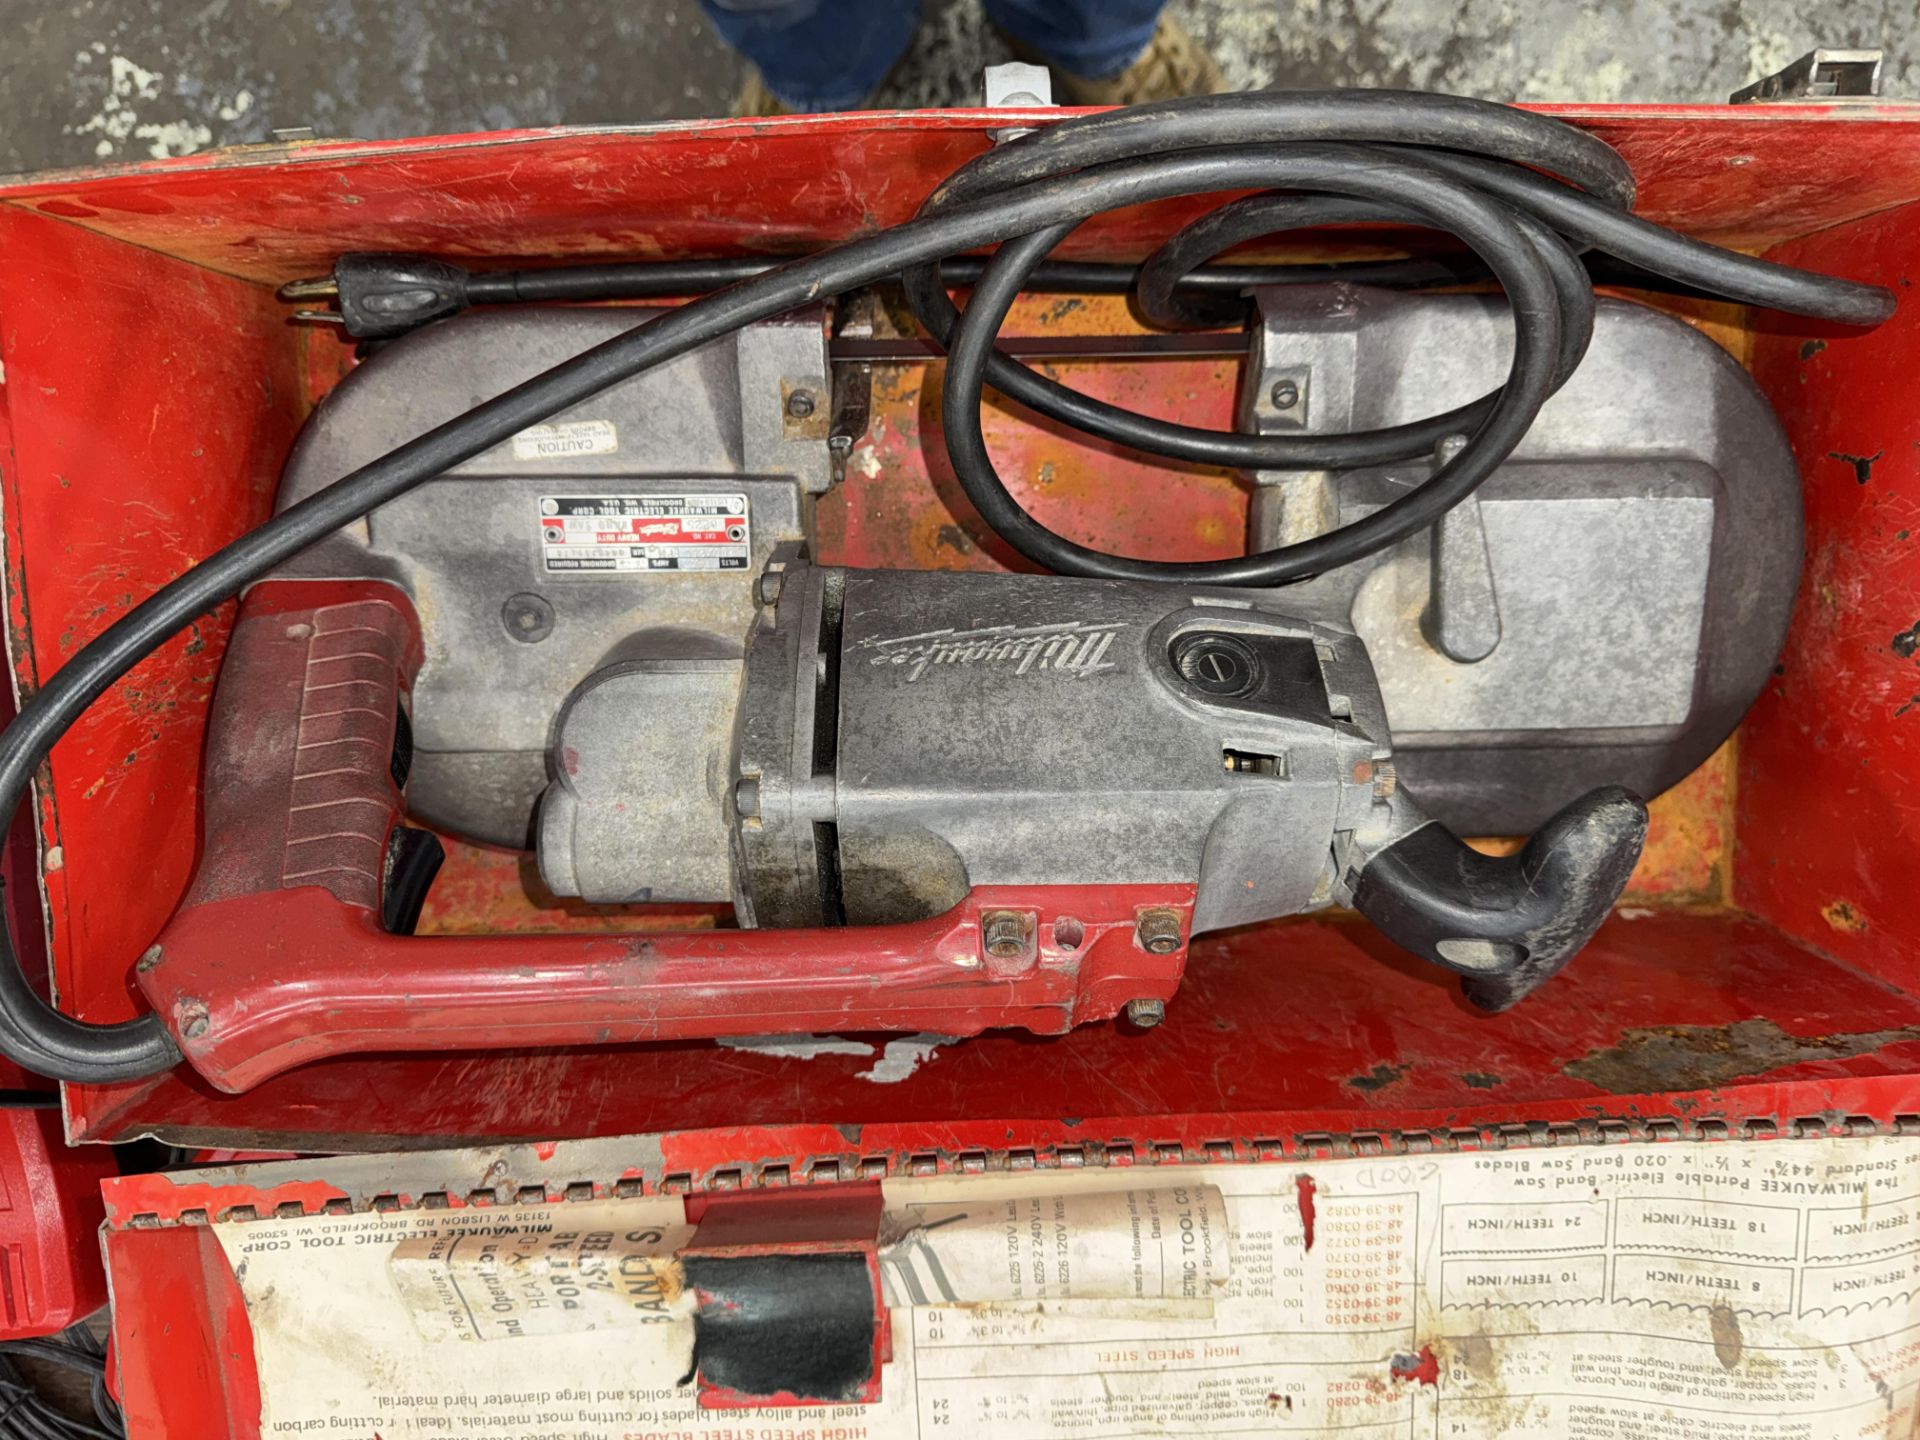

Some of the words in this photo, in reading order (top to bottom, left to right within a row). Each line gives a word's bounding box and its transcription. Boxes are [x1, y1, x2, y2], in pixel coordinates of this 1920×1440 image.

[537, 440, 592, 454] CAUTION
[569, 507, 595, 515] CORP.
[599, 507, 619, 515] TOOL
[624, 507, 664, 515] ELECTRIC
[668, 507, 717, 515] MILWAUKEE
[869, 634, 1118, 681] Milwaukee
[1473, 1160, 1530, 1174] Blades
[1540, 1159, 1574, 1173] Saw
[1582, 1156, 1624, 1170] Band
[1633, 1154, 1672, 1167] .020
[1682, 1155, 1692, 1166] x
[1825, 1159, 1898, 1177] Standard
[1513, 1177, 1545, 1189] Saw
[1555, 1175, 1596, 1188] Band
[1606, 1172, 1664, 1187] Electric
[1675, 1172, 1750, 1189] Portable
[1874, 1175, 1898, 1188] The
[1760, 1179, 1866, 1195] MILWAUKEE
[1325, 1203, 1403, 1216] 48-39-0382
[413, 1218, 434, 1227] RD.
[442, 1214, 490, 1225] LISBON
[495, 1214, 510, 1222] W.
[515, 1212, 551, 1221] 13135
[1564, 1216, 1581, 1227] 24
[1642, 1212, 1736, 1231] TEETH/INCH
[318, 1220, 407, 1234] BROOKFIELD,
[1151, 1217, 1162, 1239] Date
[1325, 1218, 1403, 1232] 48-39-0380
[1467, 1218, 1554, 1229] TEETH/INCH
[1747, 1221, 1767, 1234] 18
[1832, 1213, 1909, 1236] TEETH/INCH
[248, 1230, 288, 1240] 53005
[292, 1227, 312, 1236] WI.
[355, 1229, 438, 1245] ELECTRIC
[447, 1224, 553, 1238] MILWAUKEE
[1178, 1208, 1195, 1256] TOOL
[1247, 1231, 1273, 1239] slow
[299, 1236, 345, 1248] TOOL
[1006, 1224, 1019, 1258] 120V
[1055, 1222, 1068, 1257] 120V
[1325, 1233, 1402, 1247] 48-39-0372
[238, 1241, 291, 1253] CORP.
[1238, 1242, 1273, 1251] steels
[1325, 1249, 1402, 1262] 48-39-0370
[1283, 1267, 1304, 1277] 100
[1325, 1264, 1402, 1278] 48-39-0362
[1561, 1272, 1578, 1283] 10
[1325, 1280, 1402, 1292] 48-39-0360
[1466, 1273, 1551, 1286] TEETH/INCH
[1645, 1270, 1740, 1291] TEETH/INCH
[1832, 1269, 1906, 1292] TEETH/INCH
[1246, 1288, 1273, 1297] High
[1752, 1281, 1760, 1292] 8
[1283, 1298, 1304, 1308] 100
[1325, 1295, 1402, 1309] 48-39-0352
[447, 1309, 466, 1329] FOR
[927, 1311, 943, 1322] 10
[1325, 1311, 1401, 1324] 48-39-0350
[928, 1327, 944, 1339] 10
[1095, 1350, 1138, 1362] STEEL
[1147, 1348, 1195, 1360] SPEED
[1203, 1345, 1240, 1358] HIGH
[1587, 1353, 1623, 1362] steels
[1452, 1354, 1470, 1366] 24
[1627, 1356, 1675, 1370] tougher
[1452, 1369, 1468, 1380] 18
[1570, 1363, 1595, 1374] wall
[1598, 1365, 1621, 1376] thin
[1679, 1363, 1703, 1374] and
[1197, 1378, 1232, 1389] speed
[1235, 1377, 1260, 1386] slow
[1658, 1371, 1727, 1389] galvanized
[1286, 1382, 1306, 1392] 100
[1649, 1382, 1684, 1395] angle
[482, 1392, 551, 1406] diameter
[555, 1389, 591, 1404] large
[596, 1391, 624, 1403] and
[628, 1389, 672, 1404] solids
[1140, 1394, 1160, 1403] and
[1205, 1391, 1230, 1401] mild
[1701, 1387, 1746, 1401] cutting
[372, 1395, 438, 1410] material.
[442, 1395, 478, 1409] hard
[932, 1398, 949, 1410] 24
[1050, 1398, 1083, 1407] steels
[1131, 1402, 1192, 1415] galvanized
[662, 1409, 710, 1422] blades
[717, 1408, 750, 1421] steel
[755, 1407, 793, 1421] alloy
[798, 1408, 826, 1420] and
[832, 1406, 867, 1420] steel
[1051, 1409, 1074, 1419] wall
[1076, 1407, 1098, 1418] thin
[1212, 1410, 1245, 1422] speed
[1568, 1404, 1607, 1416] speed
[1610, 1408, 1639, 1421] slow
[330, 1415, 384, 1431] cutting
[416, 1417, 452, 1430] Ideal
[457, 1415, 531, 1429] materials.
[536, 1413, 574, 1425] most
[579, 1410, 633, 1425] cutting
[637, 1411, 658, 1424] for
[933, 1414, 950, 1425] 24
[1122, 1413, 1154, 1424] angle
[1170, 1411, 1209, 1424] cutting
[1659, 1413, 1695, 1427] cable
[273, 1418, 326, 1435] carbon
[1451, 1423, 1467, 1434] 14
[1699, 1419, 1747, 1432] electric
[699, 1430, 754, 1440] STEEL
[760, 1429, 815, 1440] SPEED
[821, 1427, 867, 1439] HIGH
